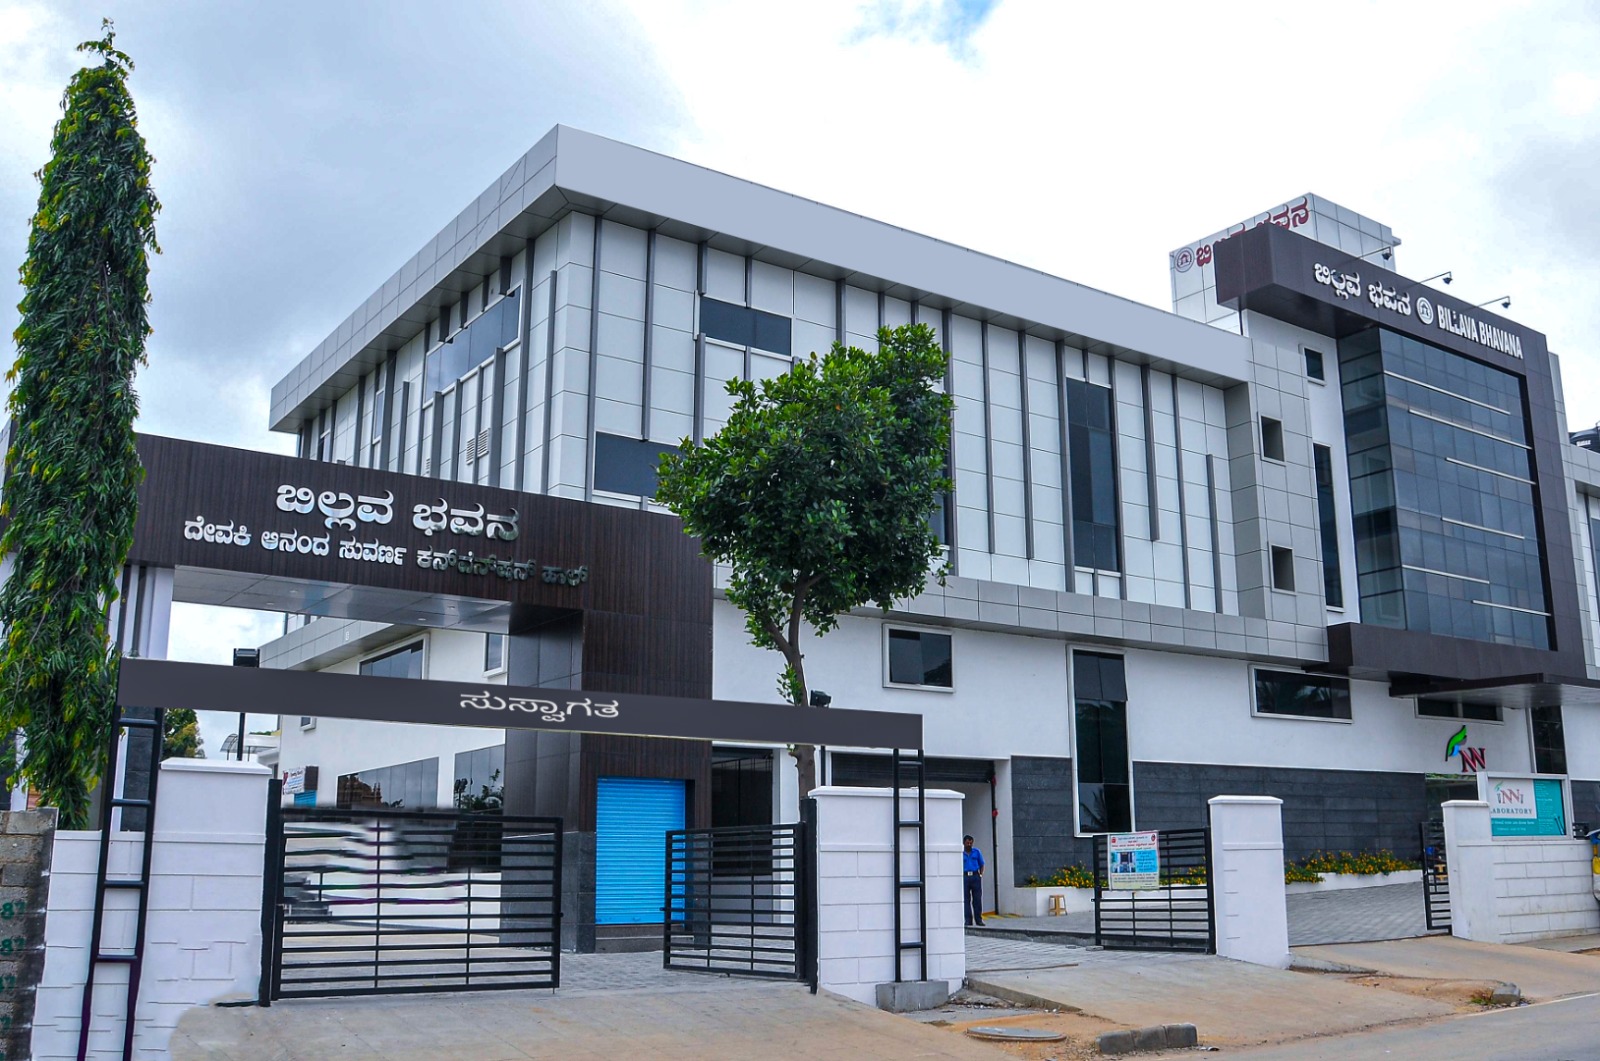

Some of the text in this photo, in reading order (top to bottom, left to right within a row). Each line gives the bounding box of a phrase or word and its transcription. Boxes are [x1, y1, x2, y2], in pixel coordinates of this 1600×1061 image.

[1314, 263, 1411, 316] ಬಿಲ್ಲವ ಭವನ
[1437, 304, 1523, 359] BILLAVA BHAVANA
[275, 484, 520, 541] ಬಿಲ್ಲವ ಭವನ
[183, 515, 252, 546] ದೇವಕಿ
[261, 528, 330, 557] ಆನಂದ
[338, 535, 407, 566] ಸುವರ್ಣ
[460, 690, 619, 723] ಸುಸ್ವಾಗತ
